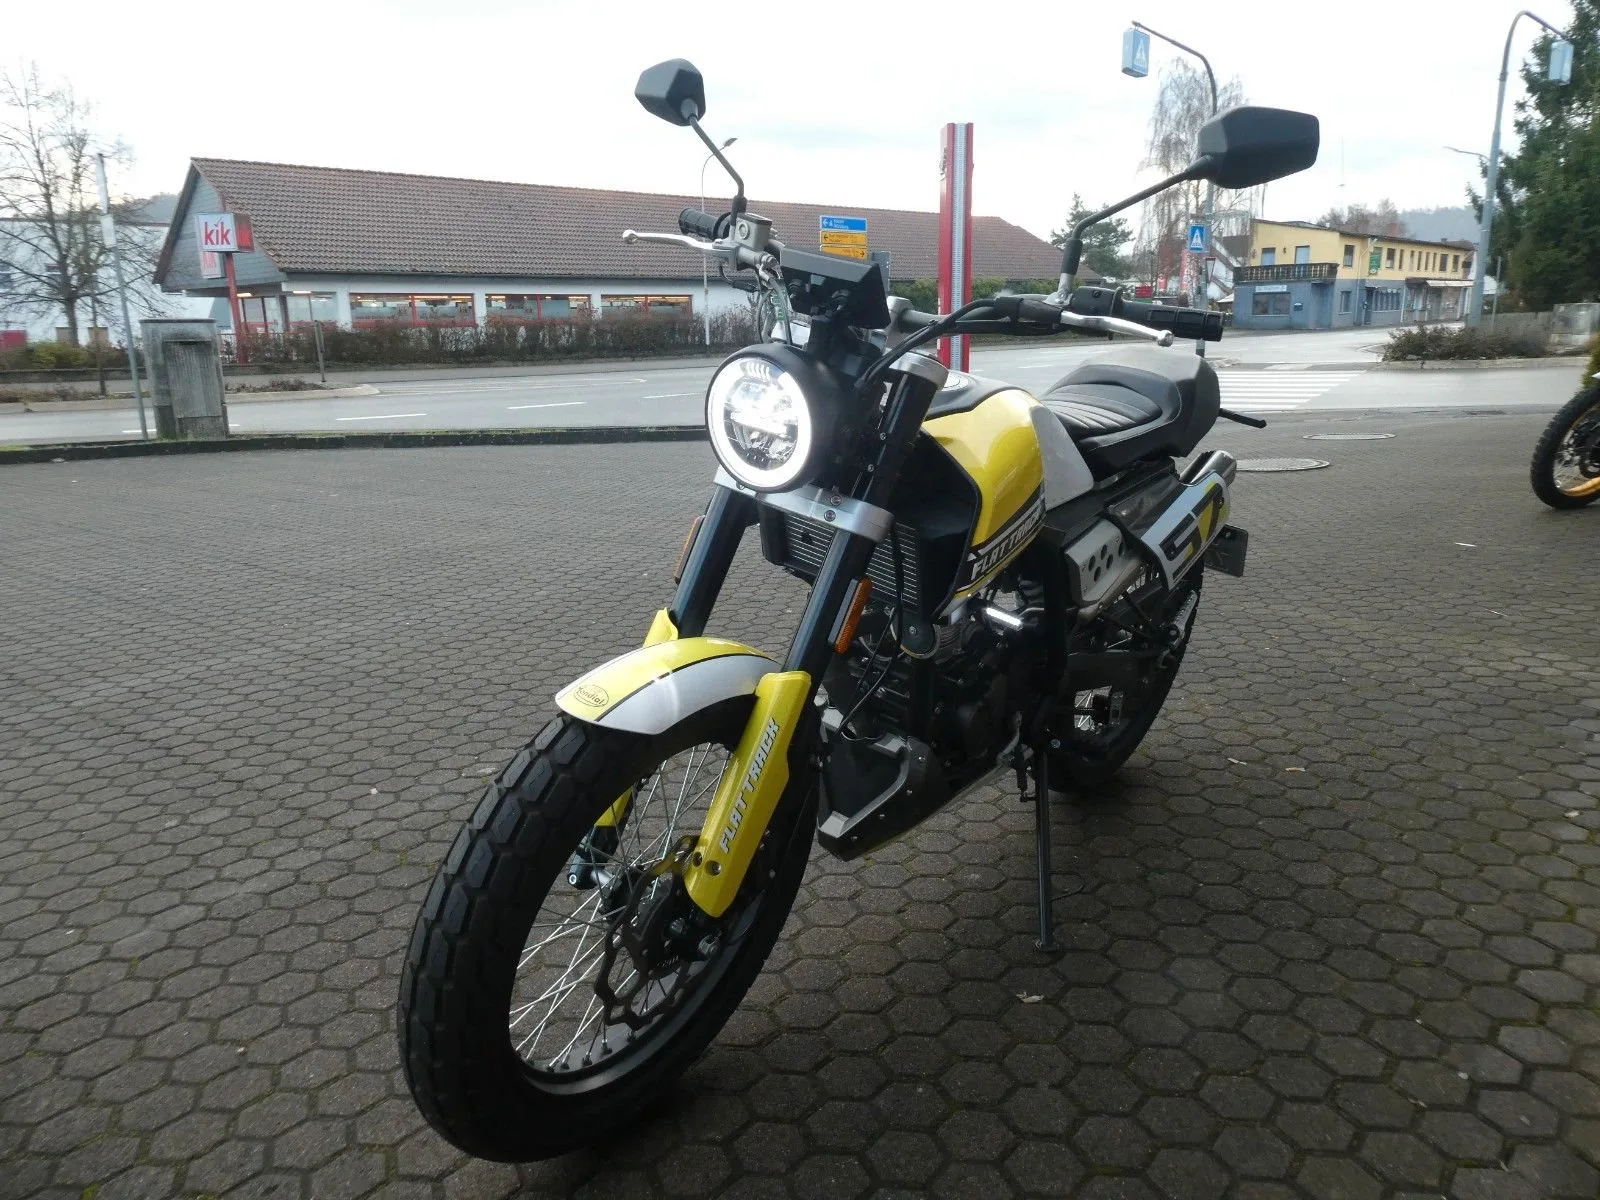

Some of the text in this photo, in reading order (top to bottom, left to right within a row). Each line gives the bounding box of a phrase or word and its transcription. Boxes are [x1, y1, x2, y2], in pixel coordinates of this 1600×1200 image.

[970, 539, 1010, 580] FLAT
[719, 717, 780, 854] FLAT TRACK
